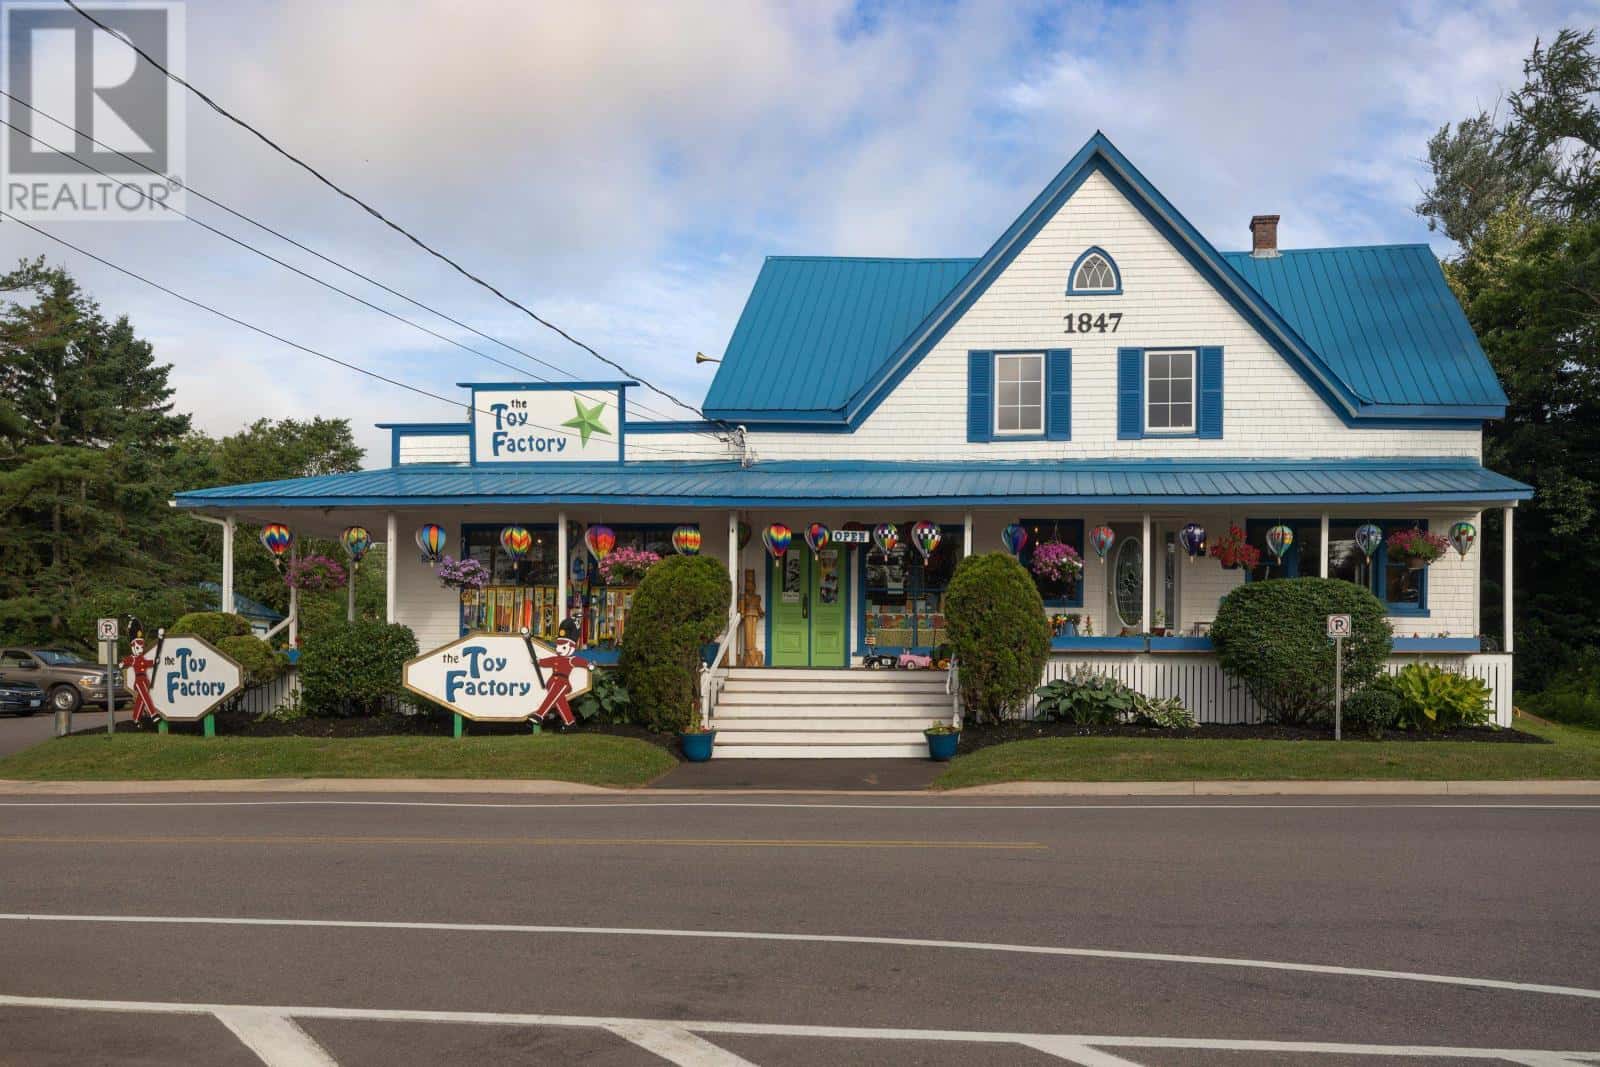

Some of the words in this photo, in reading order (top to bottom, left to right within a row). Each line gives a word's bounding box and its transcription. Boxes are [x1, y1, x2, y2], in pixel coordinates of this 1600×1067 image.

[1063, 312, 1123, 334] 1847
[490, 403, 528, 430] Toy
[511, 399, 527, 408] the
[492, 431, 567, 456] Factory
[834, 531, 865, 542] OPEN
[164, 656, 175, 666] the
[176, 647, 206, 679] Toy
[443, 653, 459, 664] the
[462, 646, 507, 679] Toy
[167, 672, 225, 704] Factory
[446, 670, 531, 703] Factory
